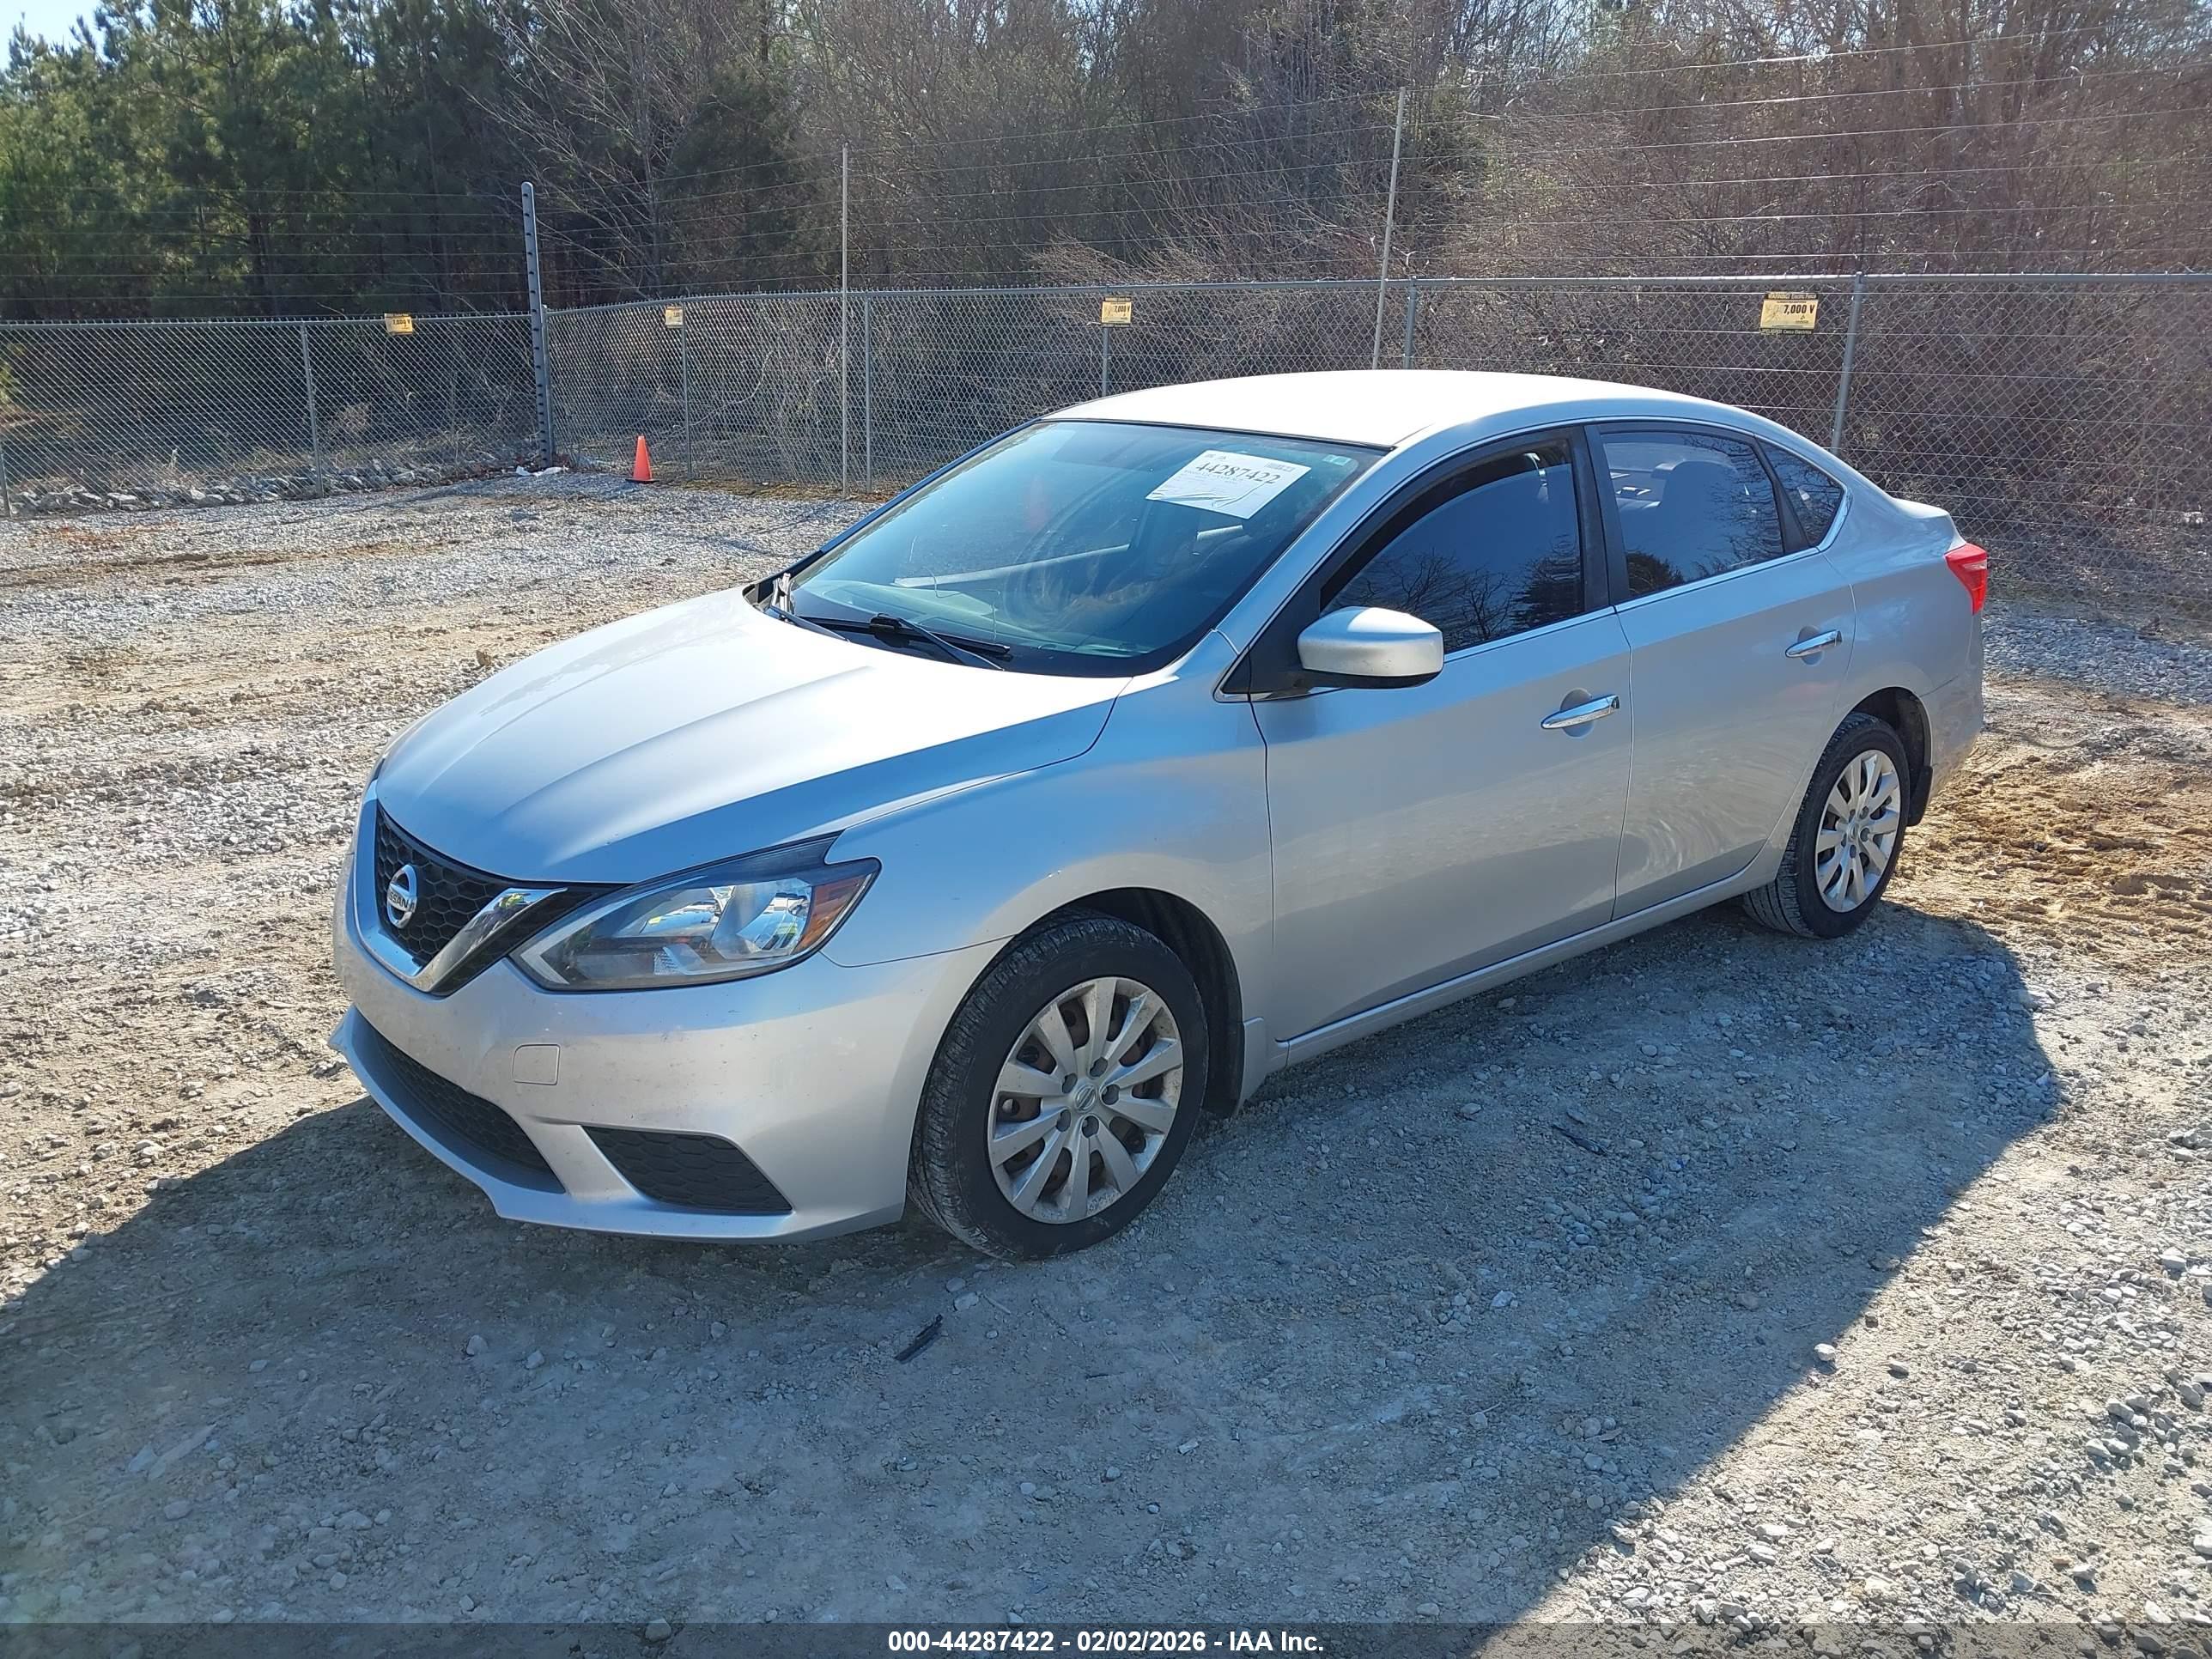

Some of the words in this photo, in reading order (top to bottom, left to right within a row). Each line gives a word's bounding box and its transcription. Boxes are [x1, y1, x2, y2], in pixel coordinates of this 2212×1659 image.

[1784, 304, 1808, 315] 7,000
[1809, 304, 1815, 314] V
[1196, 462, 1281, 484] 44287422
[388, 890, 410, 908] SSAN
